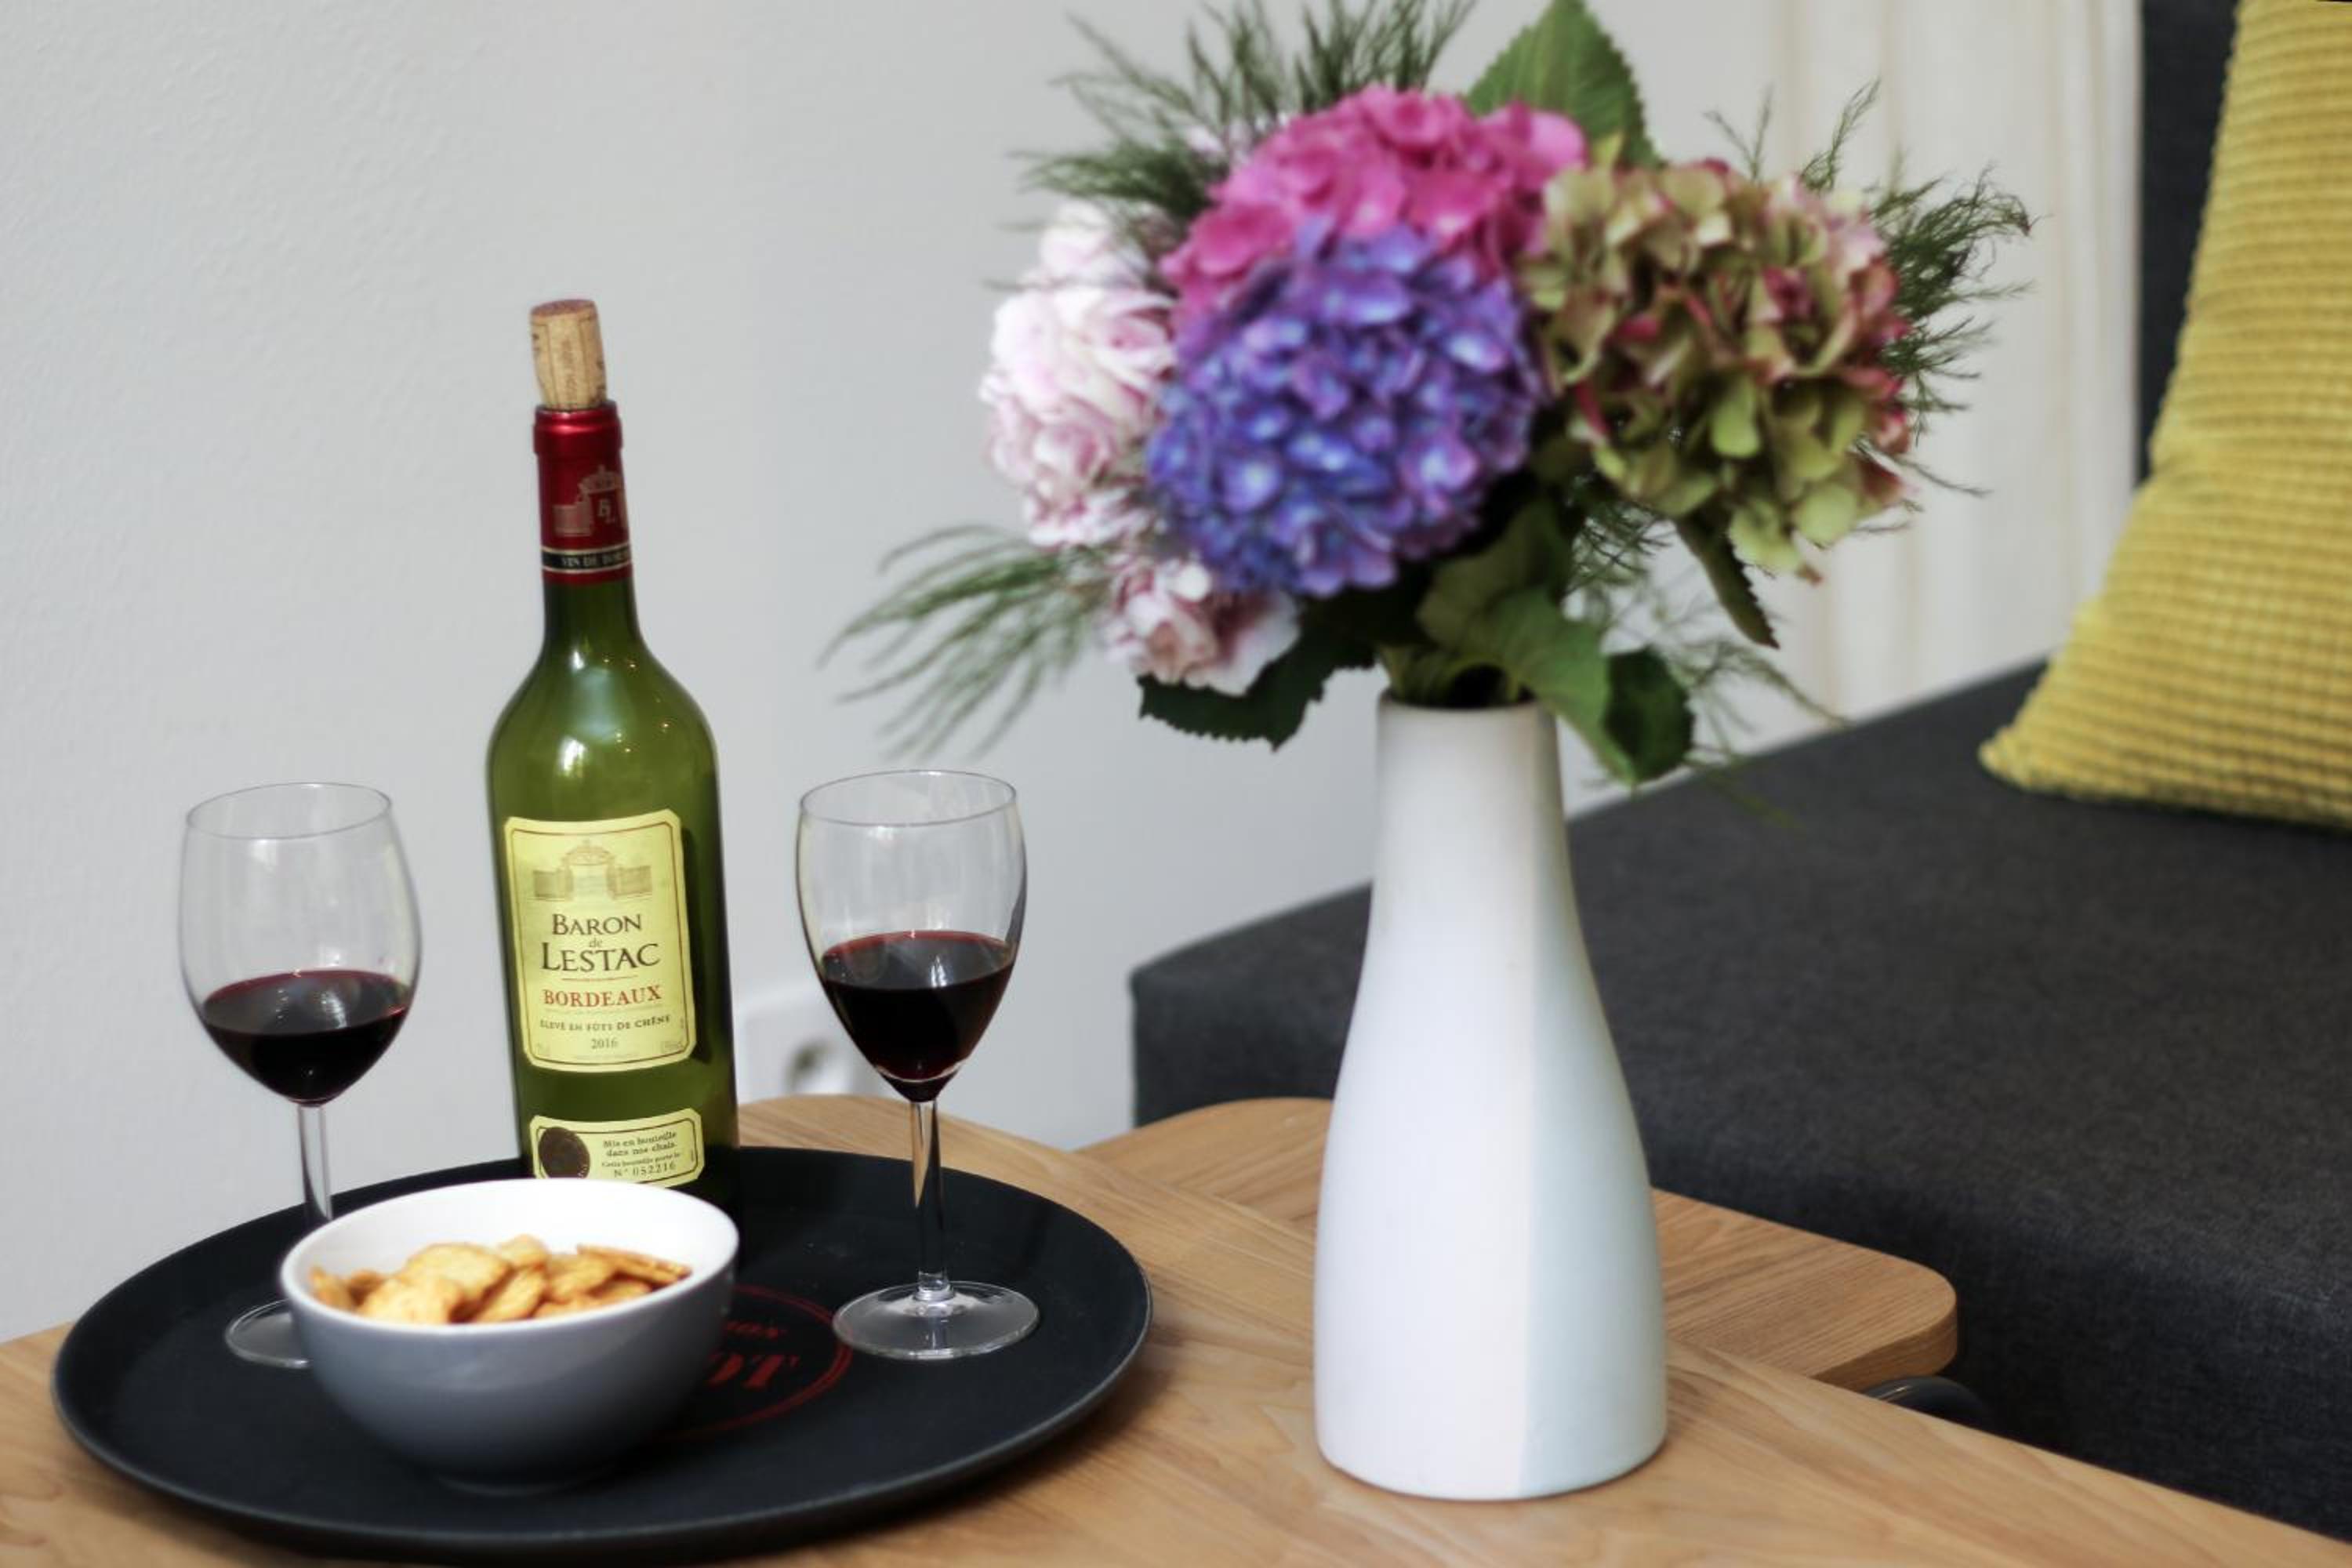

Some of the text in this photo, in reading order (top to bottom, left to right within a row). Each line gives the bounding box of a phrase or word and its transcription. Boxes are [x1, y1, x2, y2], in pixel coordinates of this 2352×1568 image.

[561, 557, 579, 567] VIN
[552, 913, 642, 935] BARON
[589, 937, 603, 948] de
[542, 942, 661, 972] LESTAC
[543, 985, 662, 1007] BORDEAUX
[616, 1022, 631, 1030] DE
[591, 1037, 618, 1049] 2016
